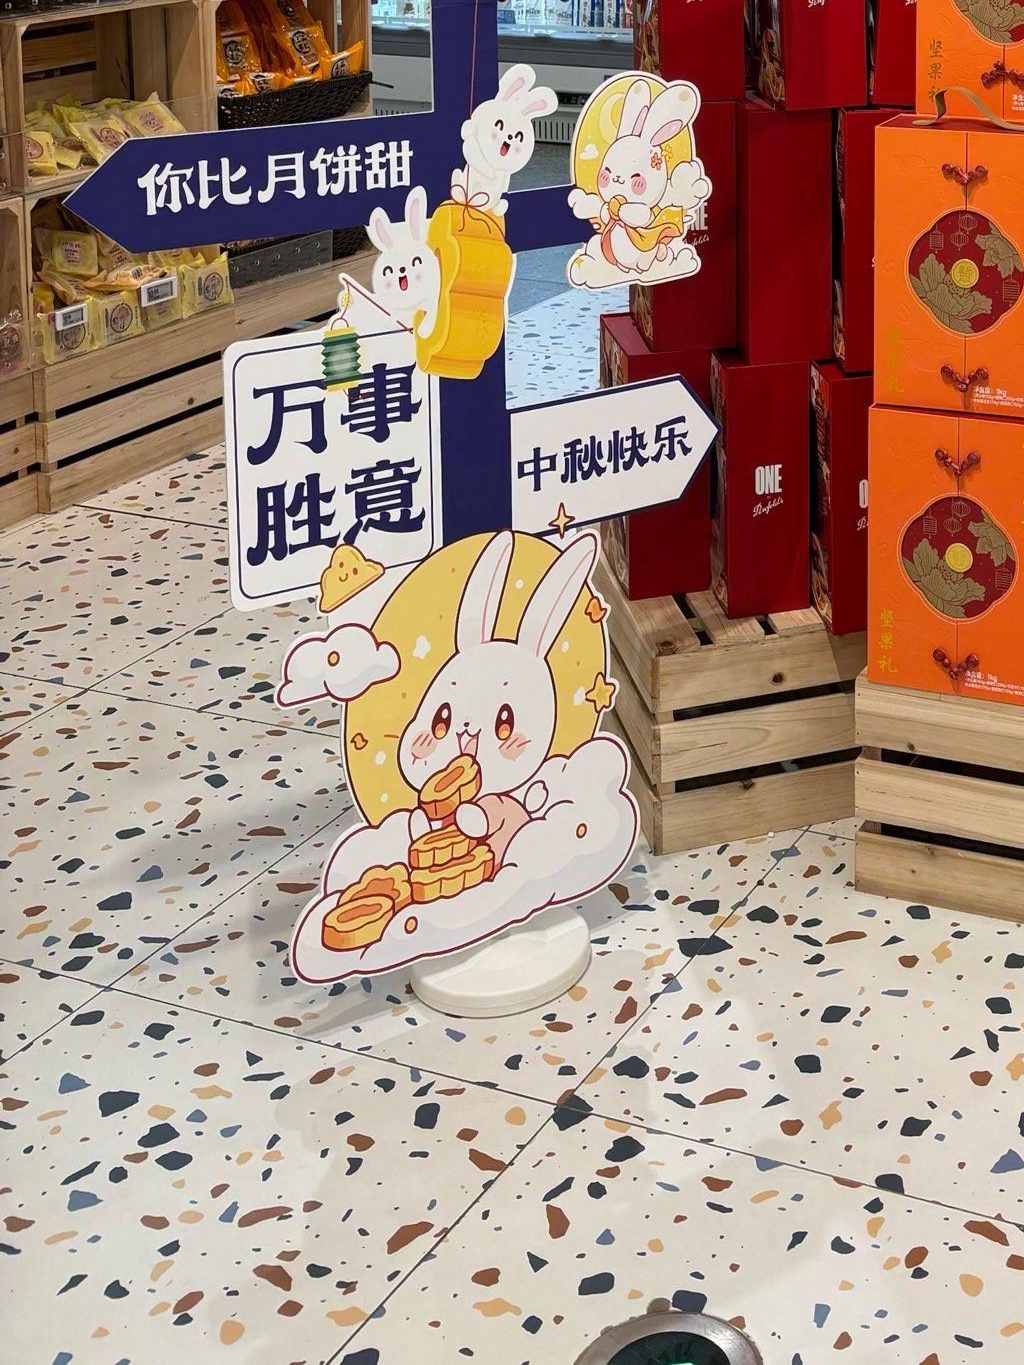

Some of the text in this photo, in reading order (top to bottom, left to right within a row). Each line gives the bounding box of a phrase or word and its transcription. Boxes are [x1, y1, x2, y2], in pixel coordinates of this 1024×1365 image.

[137, 140, 414, 218] 你比月饼甜
[246, 361, 421, 466] 万事
[516, 415, 692, 493] 中秋快乐
[755, 464, 782, 496] ONE
[246, 459, 426, 566] 胜意
[878, 609, 898, 675] 坚果礼
